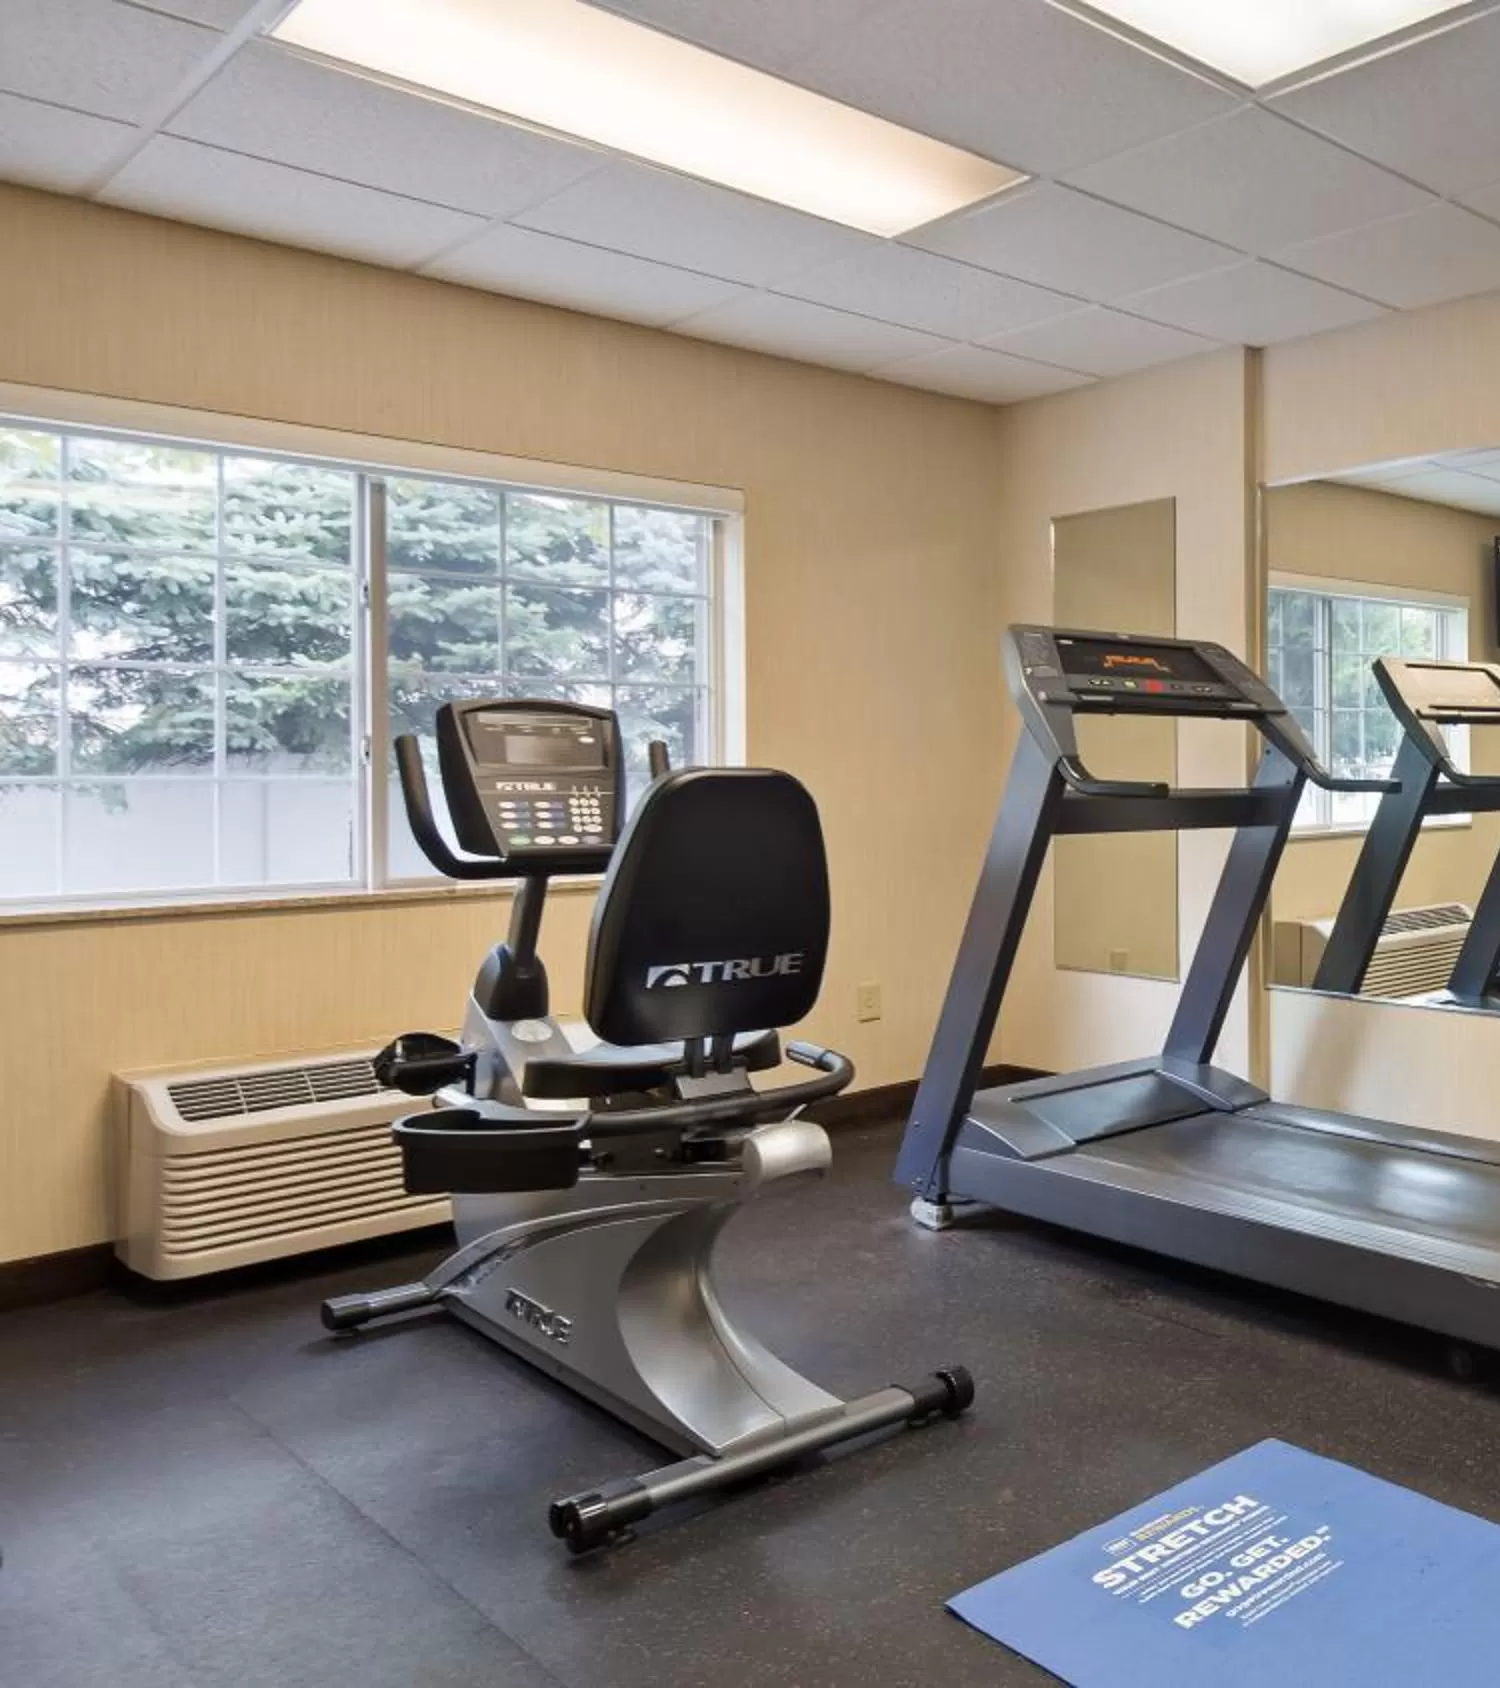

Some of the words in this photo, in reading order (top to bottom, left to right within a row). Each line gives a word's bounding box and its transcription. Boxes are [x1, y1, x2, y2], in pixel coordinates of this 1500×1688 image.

[691, 952, 805, 984] TRUE
[1091, 1494, 1260, 1590] STRETCH
[1180, 1571, 1233, 1599] GO.
[1229, 1535, 1290, 1568] GET.
